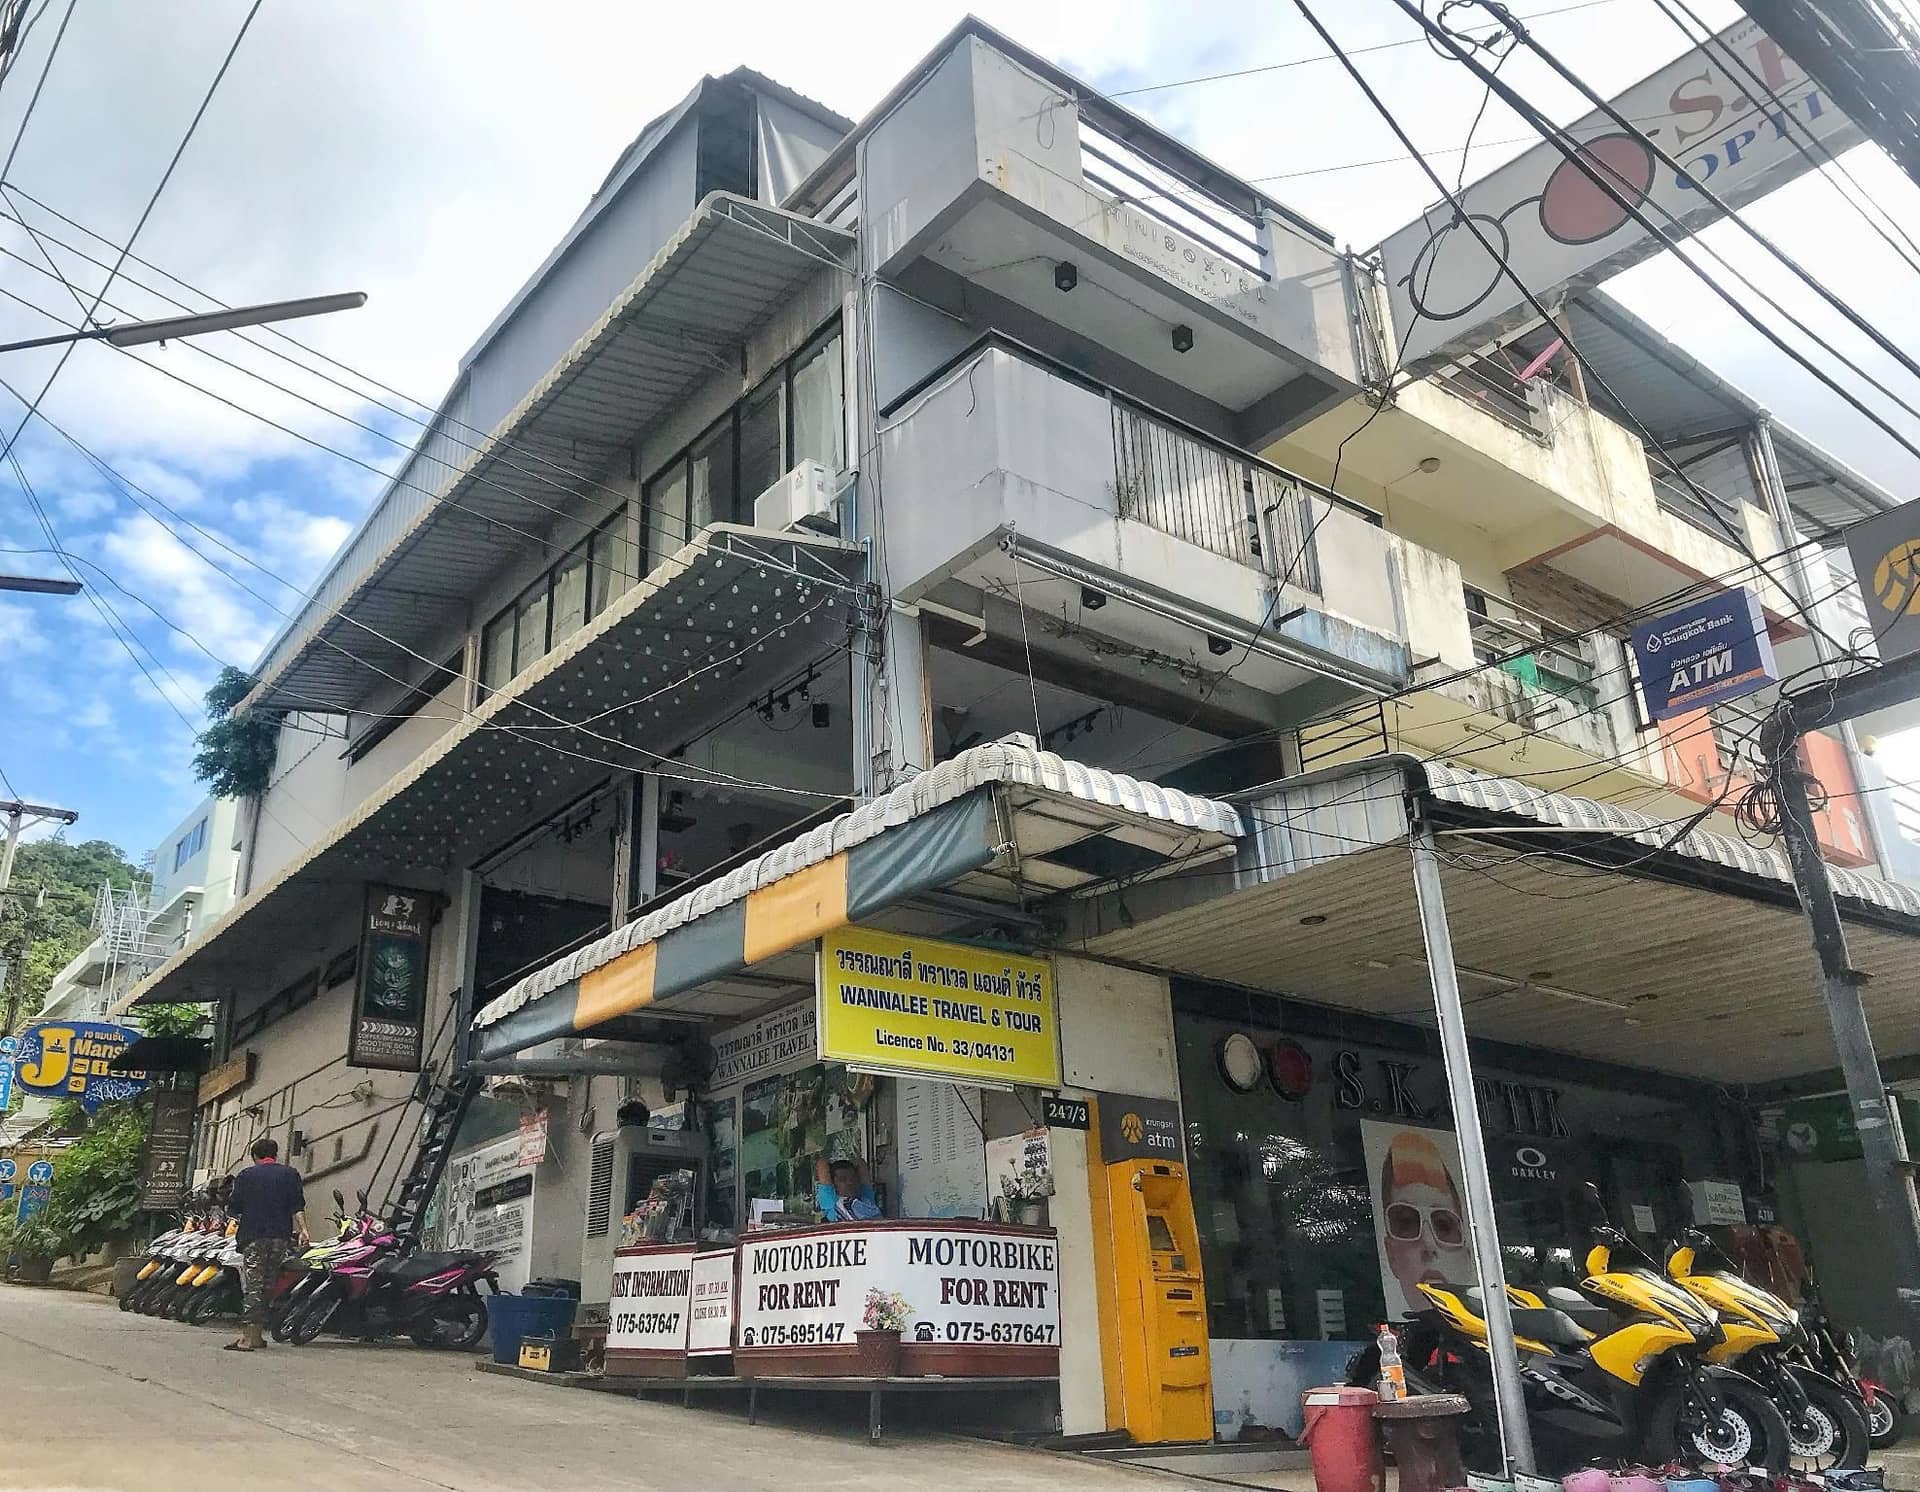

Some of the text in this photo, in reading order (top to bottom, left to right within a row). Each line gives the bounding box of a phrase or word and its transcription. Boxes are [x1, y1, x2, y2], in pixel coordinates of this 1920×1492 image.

[1663, 614, 1734, 646] Bangkok Bank
[1669, 649, 1732, 693] ATM
[836, 949, 1042, 1001] วรรณณาลี ทราเวล แอนด์ ทัวร์
[839, 984, 1042, 1033] WANNALEE TRAVEL & TOUR
[21, 1028, 75, 1087] J
[73, 1039, 129, 1059] Mans
[717, 1033, 810, 1079] WANNALEE TRAVEL
[876, 1028, 1015, 1062] Licence No. 33/04131
[1049, 1103, 1086, 1124] 247/3
[1473, 1074, 1574, 1138] PTIK
[1146, 1118, 1174, 1129] krungsri
[1147, 1132, 1176, 1149] atm
[1511, 1167, 1557, 1181] OAKLEY
[753, 1238, 867, 1274] MOTORBIKE
[908, 1237, 1055, 1271] MOTORBIKE
[631, 1269, 691, 1298] INFORMATION
[758, 1279, 840, 1311] FOR RENT
[940, 1277, 1049, 1309] FOR RENT
[616, 1313, 680, 1334] 075-637647
[946, 1321, 1056, 1344] 075-637647
